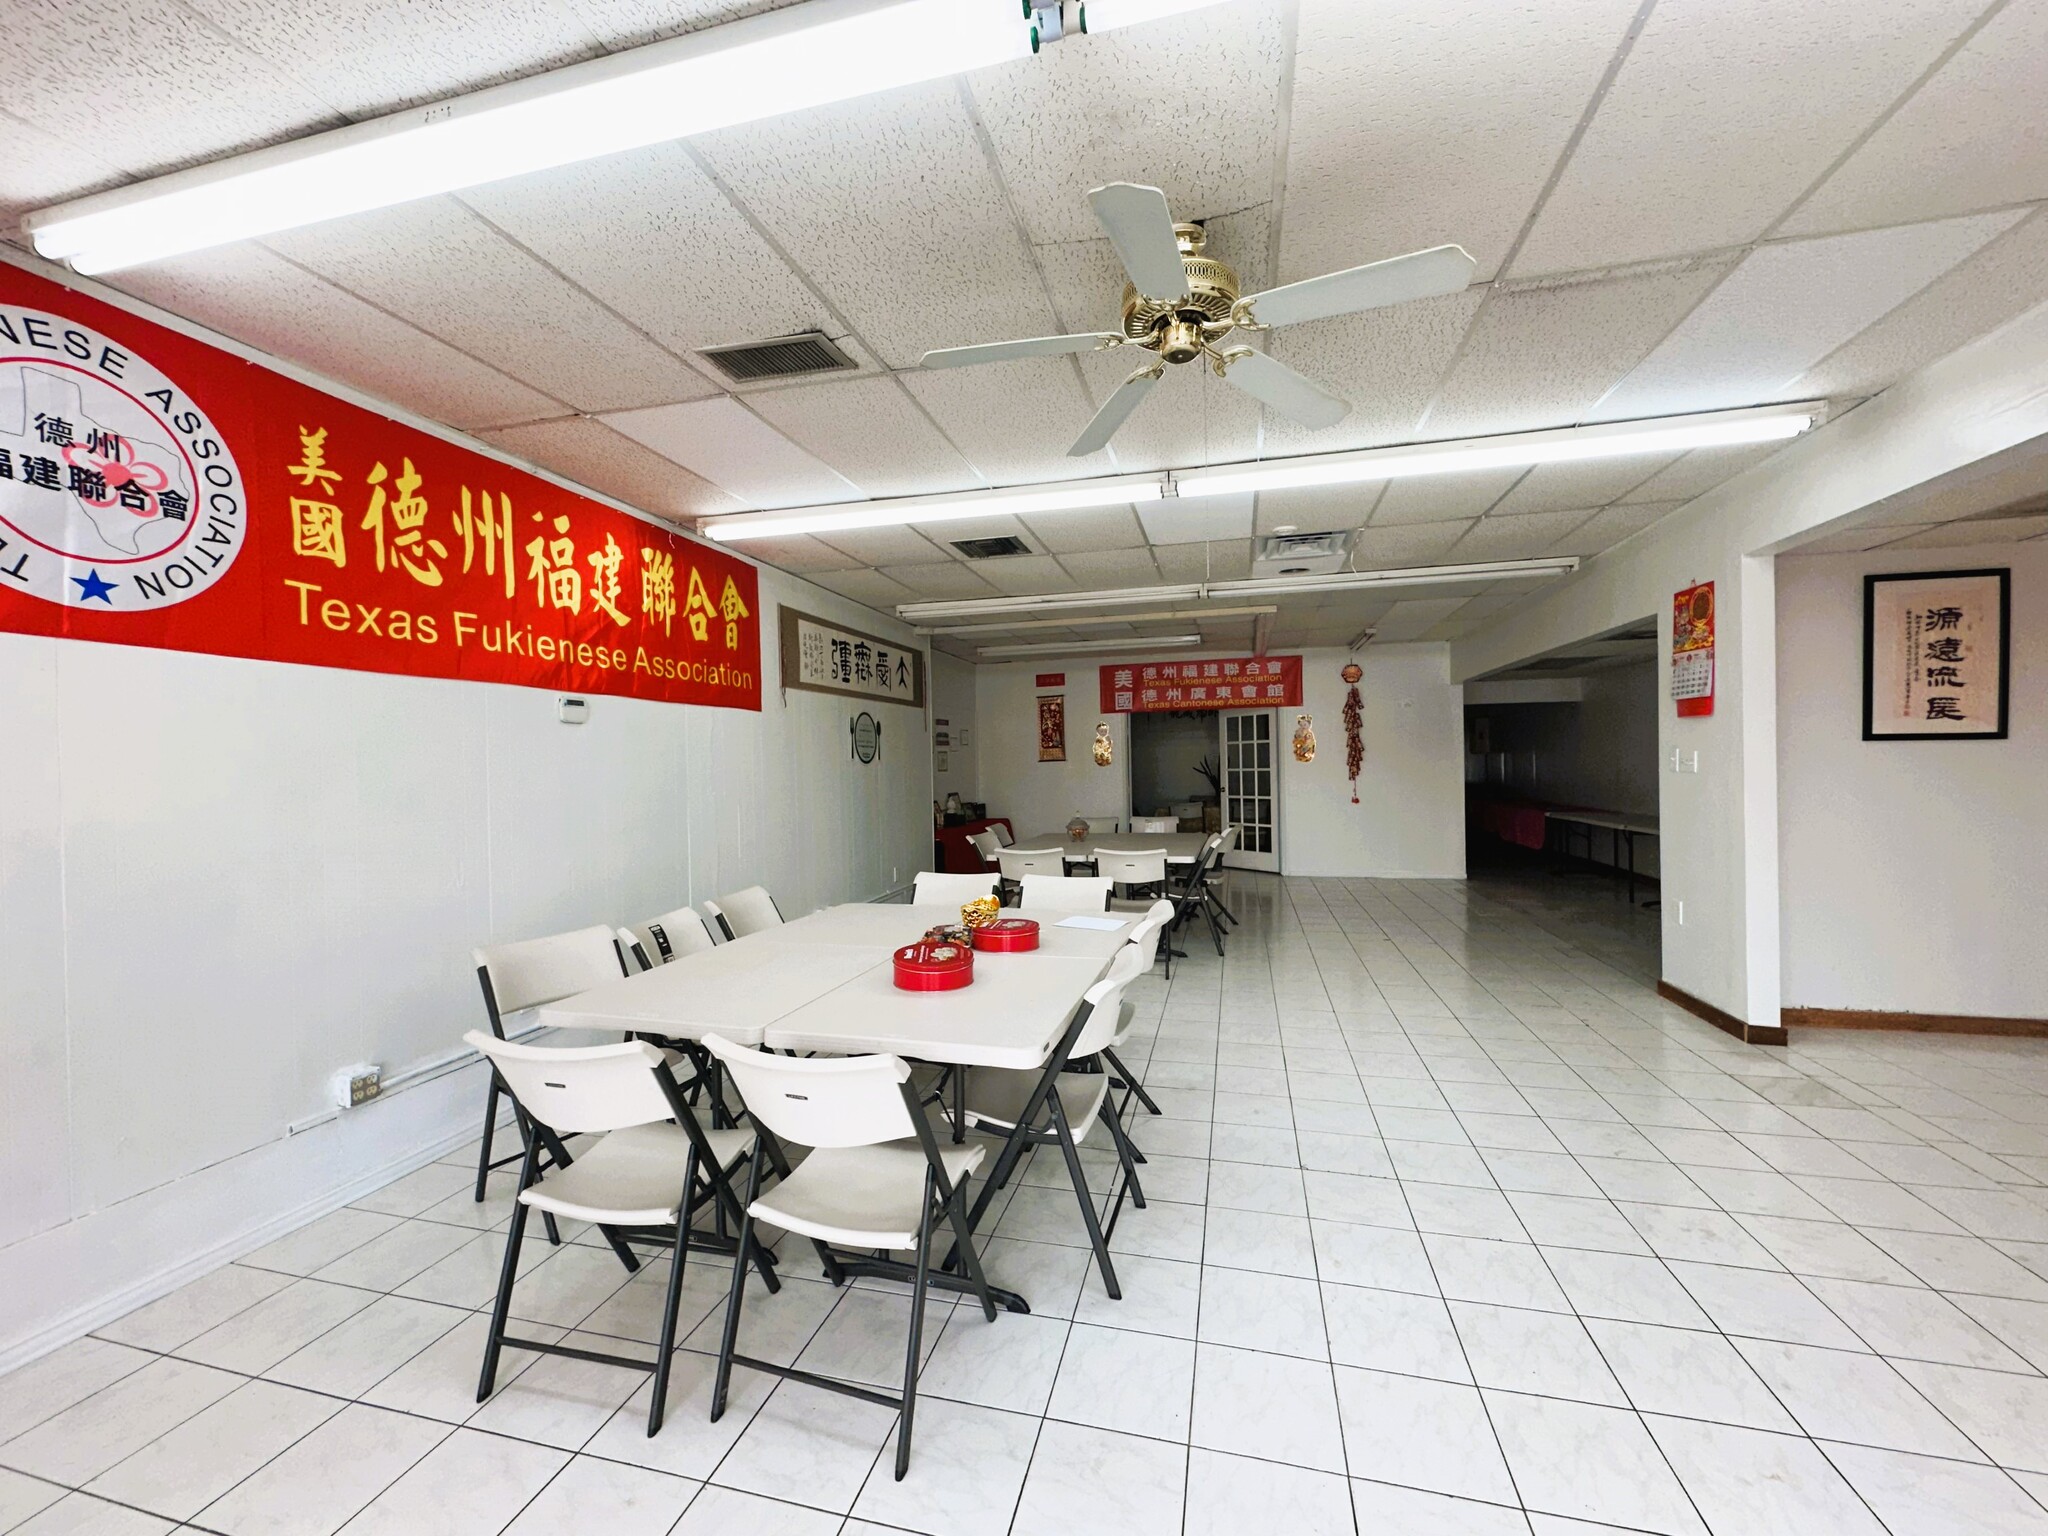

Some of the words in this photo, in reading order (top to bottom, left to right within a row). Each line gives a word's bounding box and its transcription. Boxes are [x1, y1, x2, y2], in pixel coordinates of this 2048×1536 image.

[34, 412, 121, 463] 德州
[133, 388, 237, 600] ASSOCIATION
[287, 425, 347, 568] 美國
[360, 456, 749, 651] 德州福建聯合會
[284, 579, 439, 645] Texas
[453, 611, 627, 672] Fukienese
[633, 646, 753, 690] Association
[1114, 670, 1133, 711] 美國
[1142, 661, 1282, 680] 德州福建聯合會
[1144, 679, 1171, 687] Texas
[1174, 677, 1222, 686] Fukienese
[1225, 674, 1282, 683] Association
[1173, 699, 1224, 707] Cantonese
[1228, 697, 1284, 706] Association
